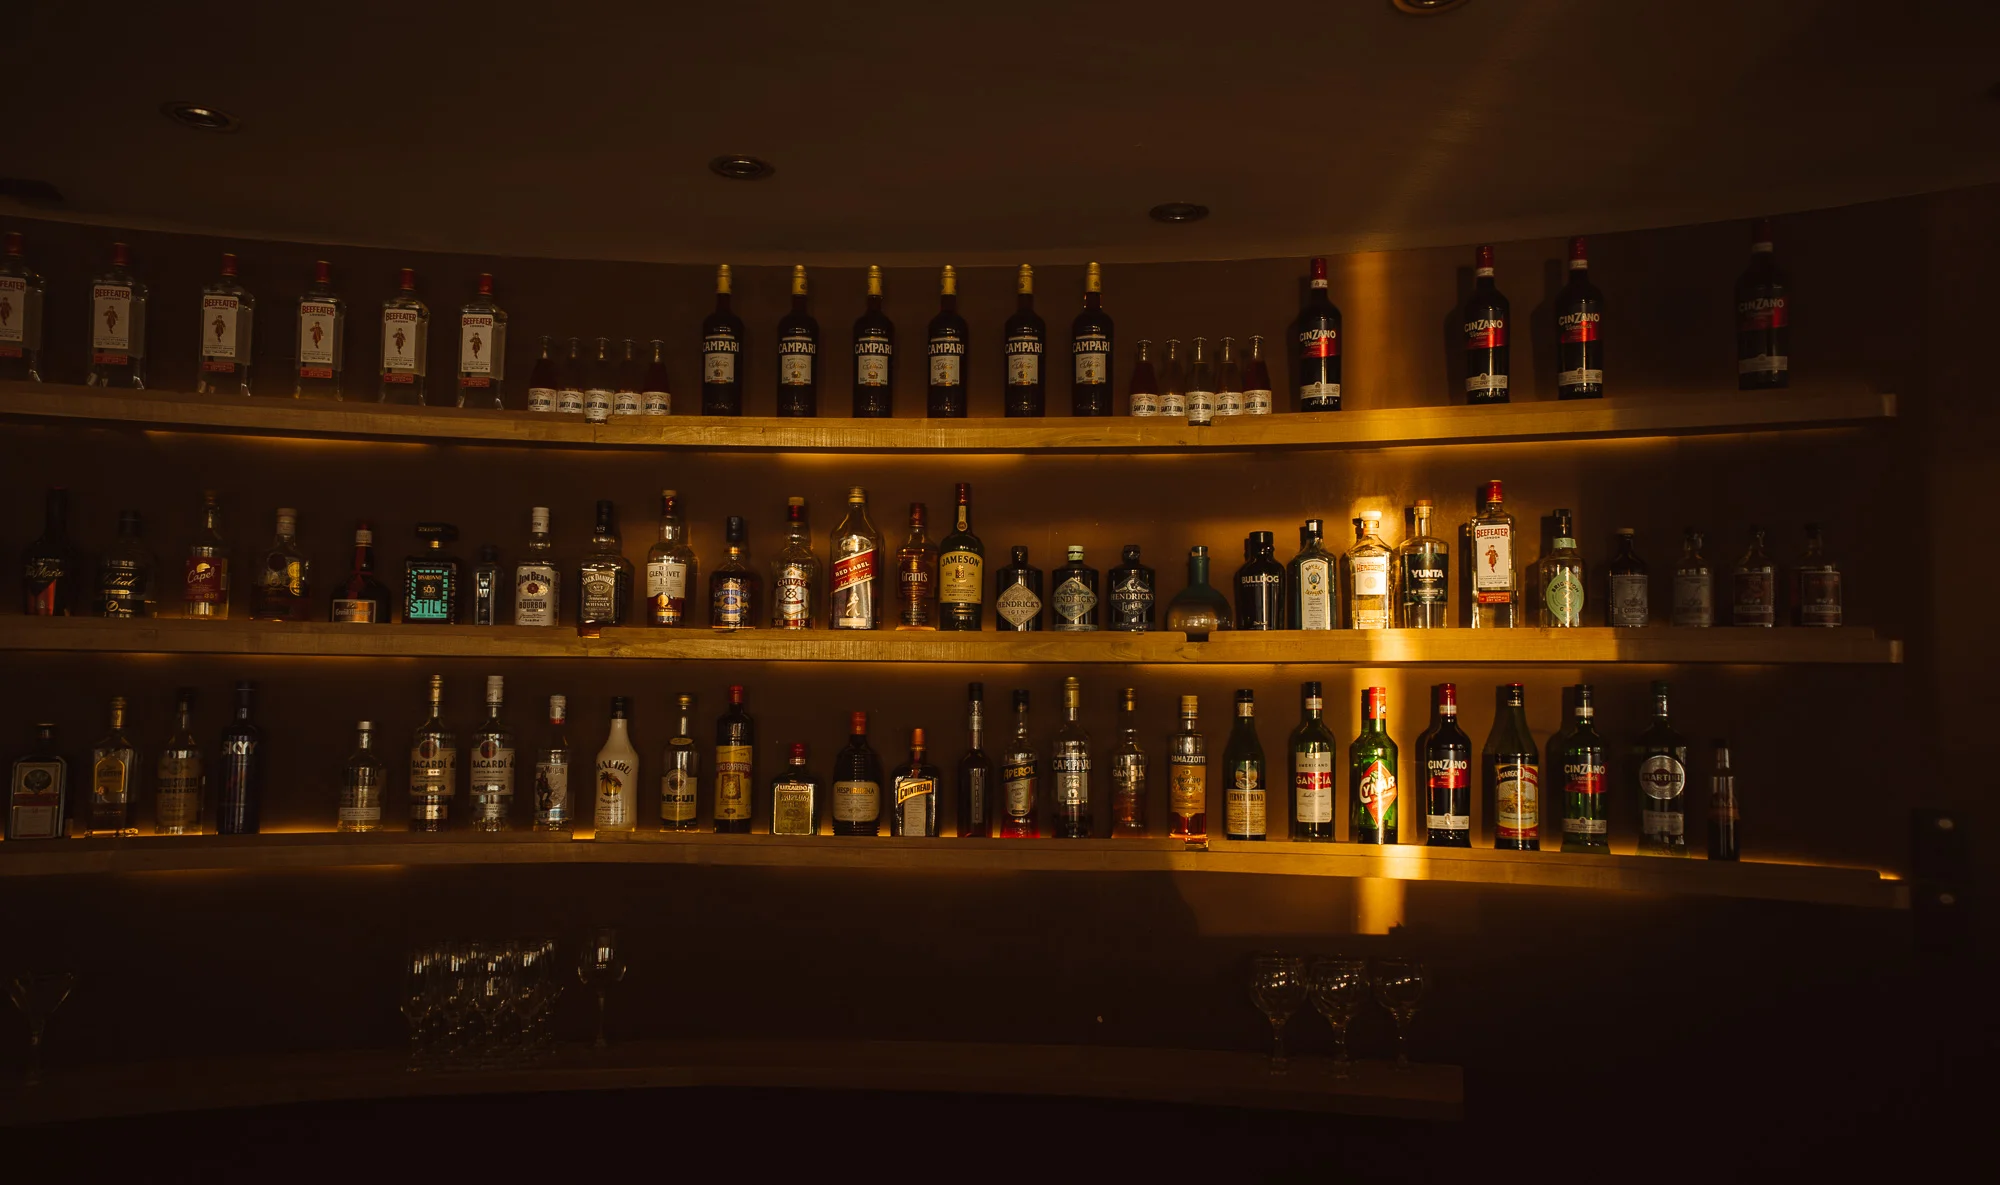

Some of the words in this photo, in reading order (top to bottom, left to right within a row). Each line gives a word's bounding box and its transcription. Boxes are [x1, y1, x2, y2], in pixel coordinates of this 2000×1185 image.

[0, 280, 25, 292] FEATER
[95, 288, 130, 300] BEEFEATER
[204, 298, 238, 309] BEEFEATER
[1739, 297, 1785, 312] CINZANO
[302, 305, 335, 316] BEEFEATER
[386, 312, 417, 323] BEEFEATER
[463, 317, 493, 327] BEEFEATER
[1559, 312, 1600, 326] CINZANO
[1464, 319, 1503, 333] CINZANO
[1299, 329, 1336, 342] CINZANO
[703, 341, 740, 353] CAMPARI
[779, 342, 816, 354] CAMPARI
[855, 342, 892, 354] CAMPARI
[928, 343, 964, 355] CAMPARI
[1005, 342, 1043, 354] CAMPARI
[1072, 341, 1110, 353] CAMPARI
[1476, 528, 1509, 539] BEEFEATER
[942, 555, 981, 568] JAMESON
[187, 566, 216, 583] Capel
[835, 569, 848, 577] RED
[849, 561, 870, 573] LABEL
[1411, 569, 1444, 578] YUNTA
[518, 574, 531, 586] JIM
[531, 572, 551, 586] BEAM
[582, 575, 595, 586] JACK
[777, 579, 807, 587] CHIVAS
[1242, 575, 1279, 584] BULLDOG
[1552, 581, 1579, 593] BRIGTON
[410, 601, 447, 614] STILE
[519, 601, 547, 609] BOURBON
[472, 758, 507, 769] BACARDÍ
[1171, 755, 1206, 763] RAMAZZOTTI
[1428, 759, 1468, 770] CINZANO
[597, 760, 632, 776] MALIBU
[1004, 766, 1035, 780] APEROL
[1564, 764, 1605, 775] CINZANO
[1296, 776, 1332, 785] GANCIA
[1644, 774, 1681, 782] MARTINI
[900, 782, 931, 799] COINTREAU
[1359, 776, 1396, 804] CYNAR
